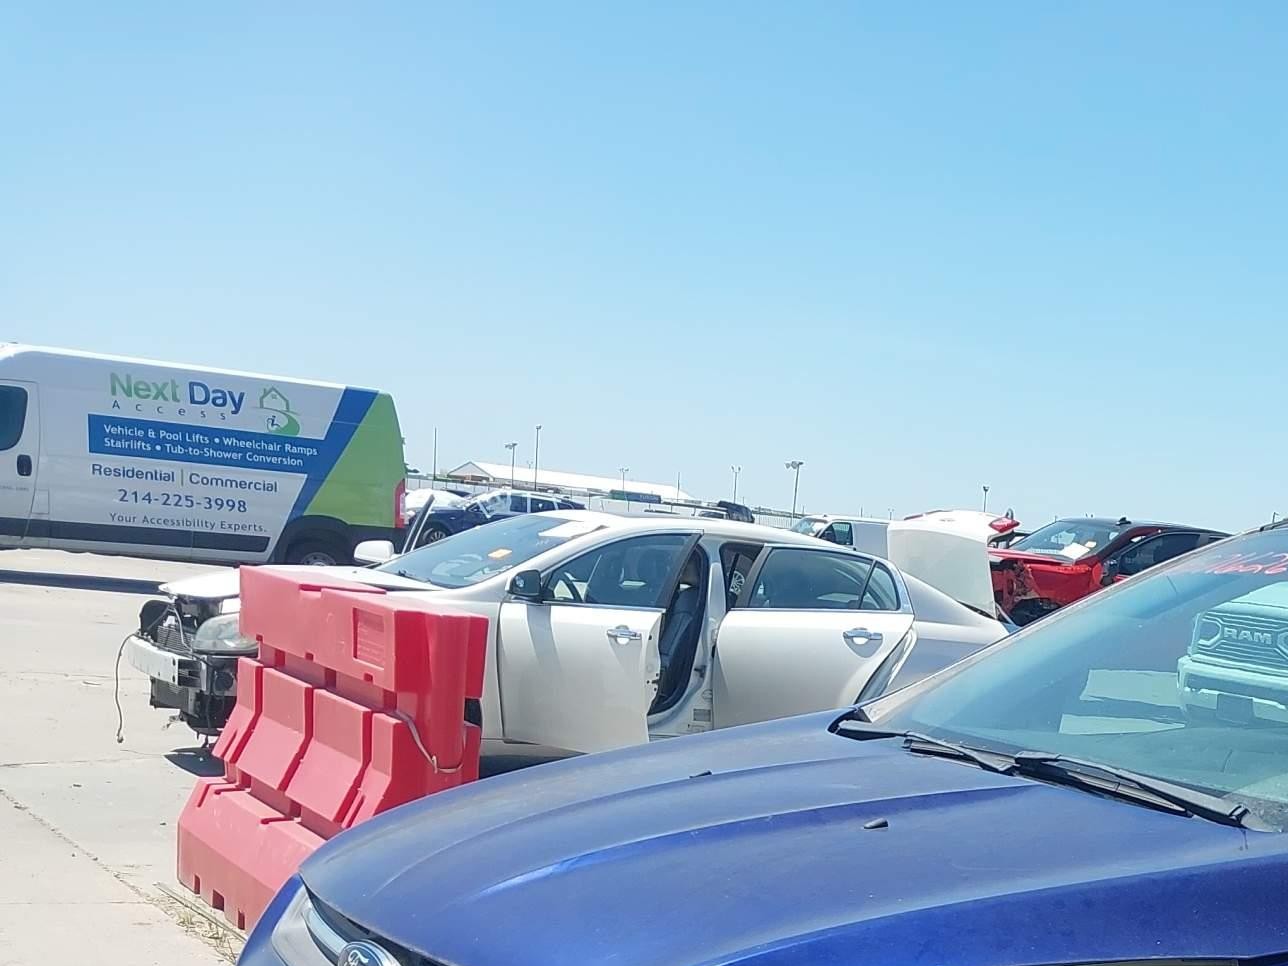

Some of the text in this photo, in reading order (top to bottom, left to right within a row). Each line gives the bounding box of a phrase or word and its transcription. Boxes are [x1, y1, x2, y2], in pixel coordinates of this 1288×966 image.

[110, 372, 245, 415] Next Day
[112, 400, 226, 420] Access
[103, 424, 318, 457] Vehicle & Pool Lifts Wheelchair Ramps
[104, 437, 304, 467] Stairlifts Tub-to-Shower Conversion
[91, 463, 278, 493] Residential Commercial
[117, 488, 248, 513] 214-225-3998
[109, 512, 137, 524] Your
[142, 514, 216, 531] Accessibility
[1223, 627, 1273, 645] RAM
